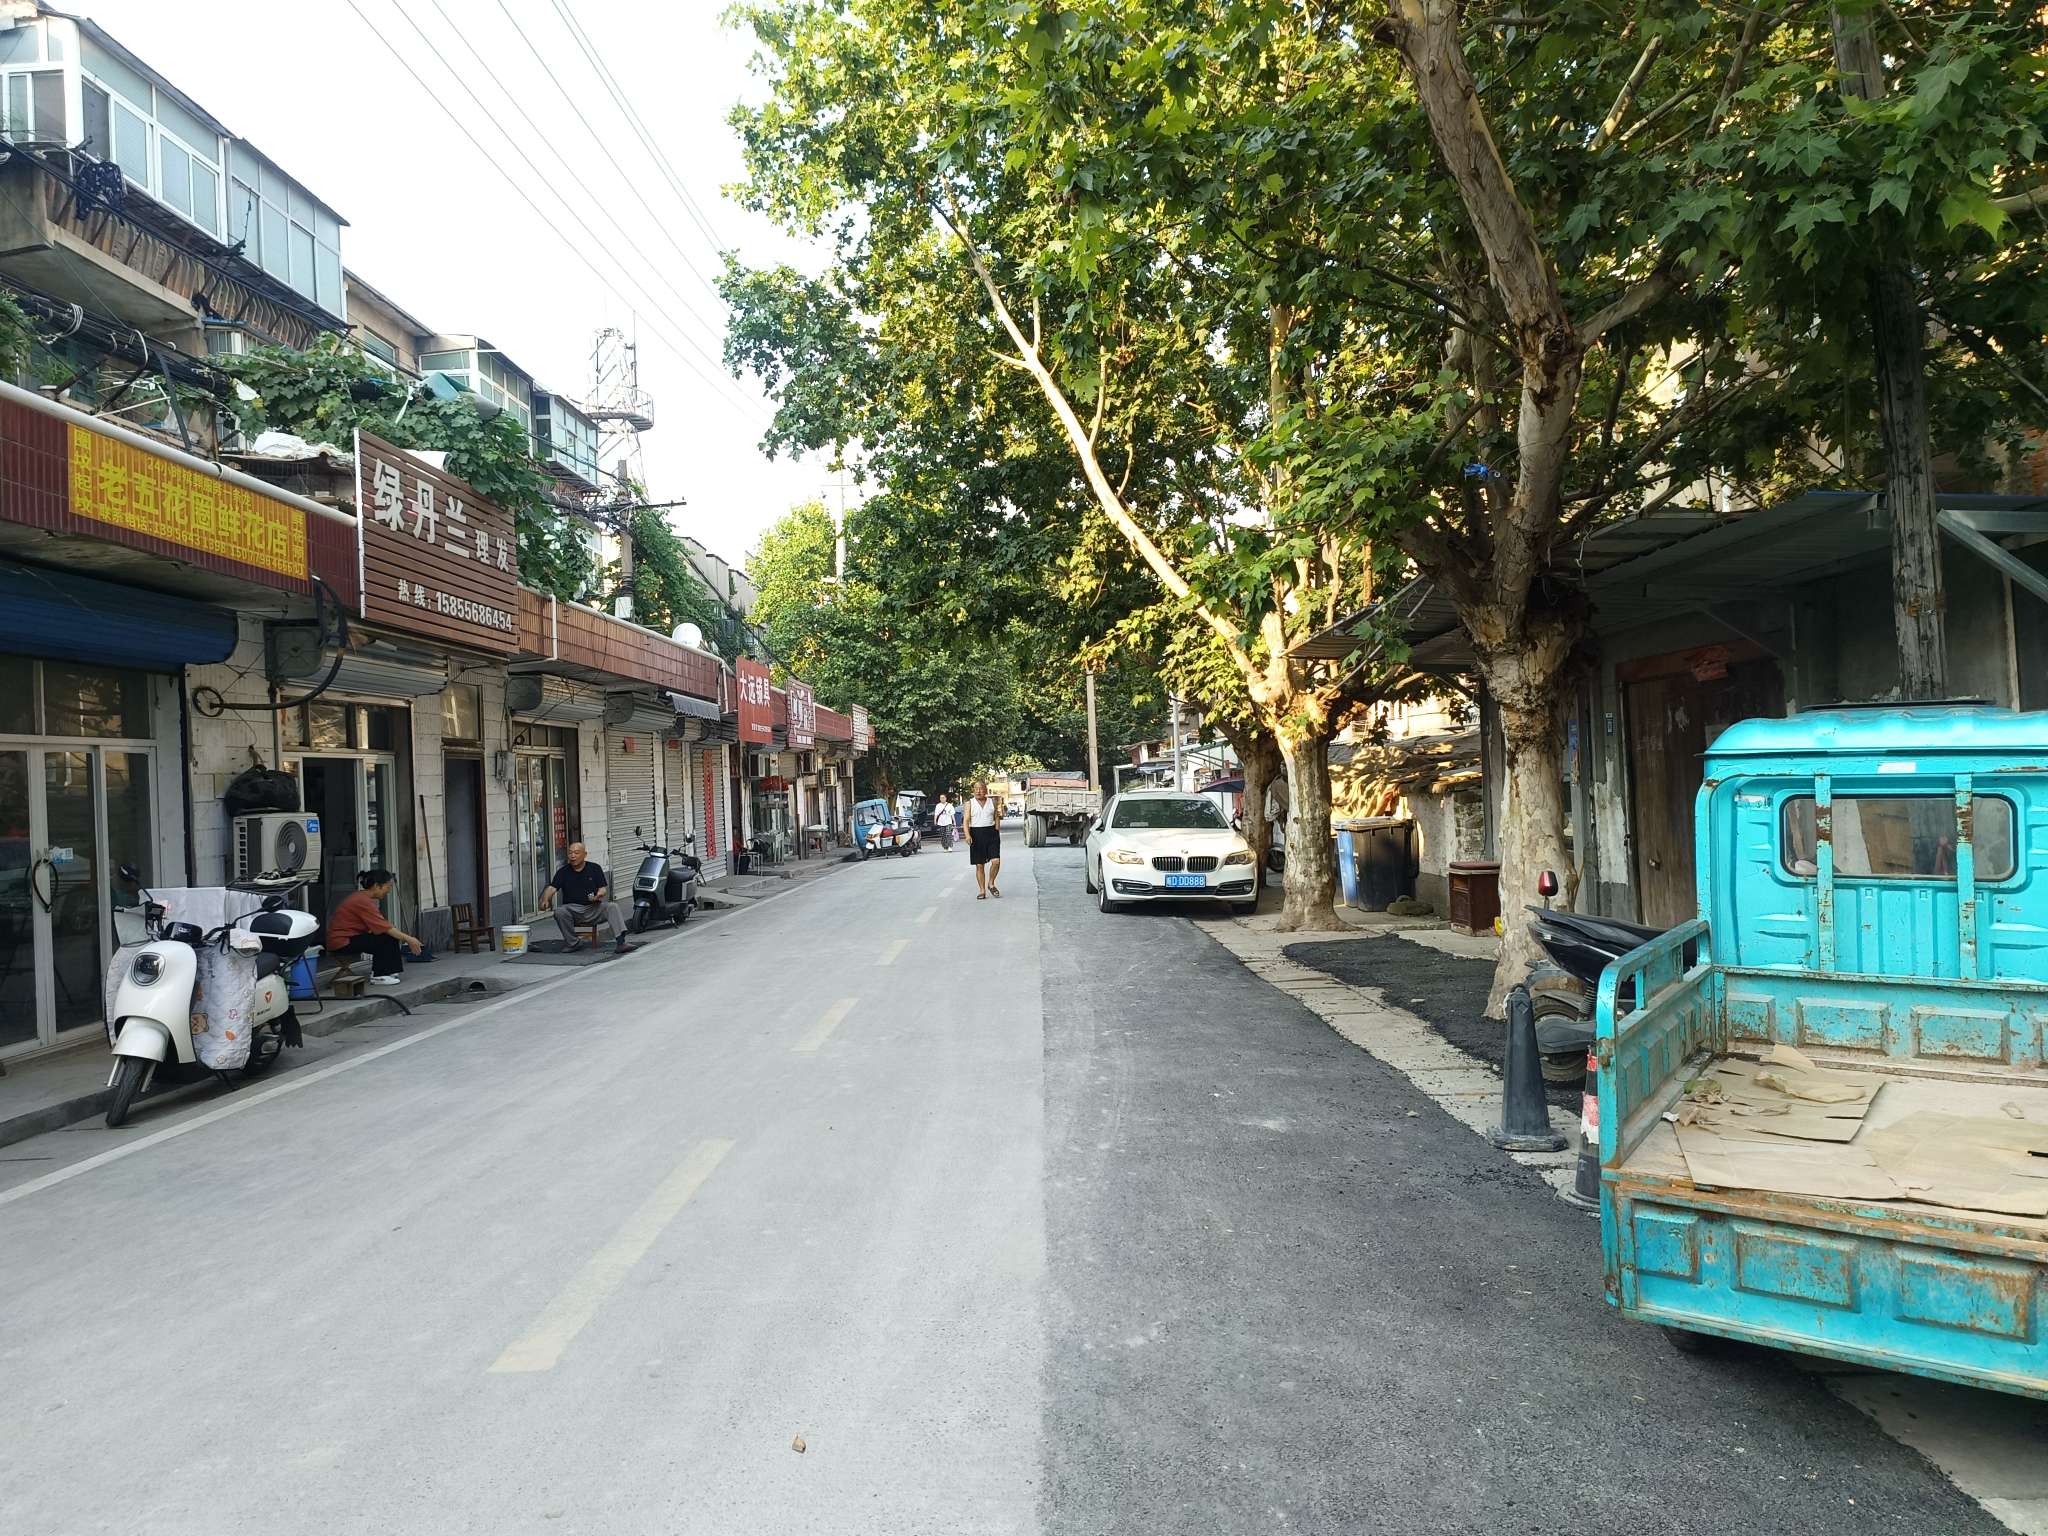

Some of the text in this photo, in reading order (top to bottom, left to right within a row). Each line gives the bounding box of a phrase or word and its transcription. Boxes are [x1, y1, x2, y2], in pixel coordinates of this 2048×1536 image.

[98, 459, 289, 561] 老五花圈鲜花店
[373, 458, 470, 559] 绿丹兰
[475, 529, 509, 573] 理发
